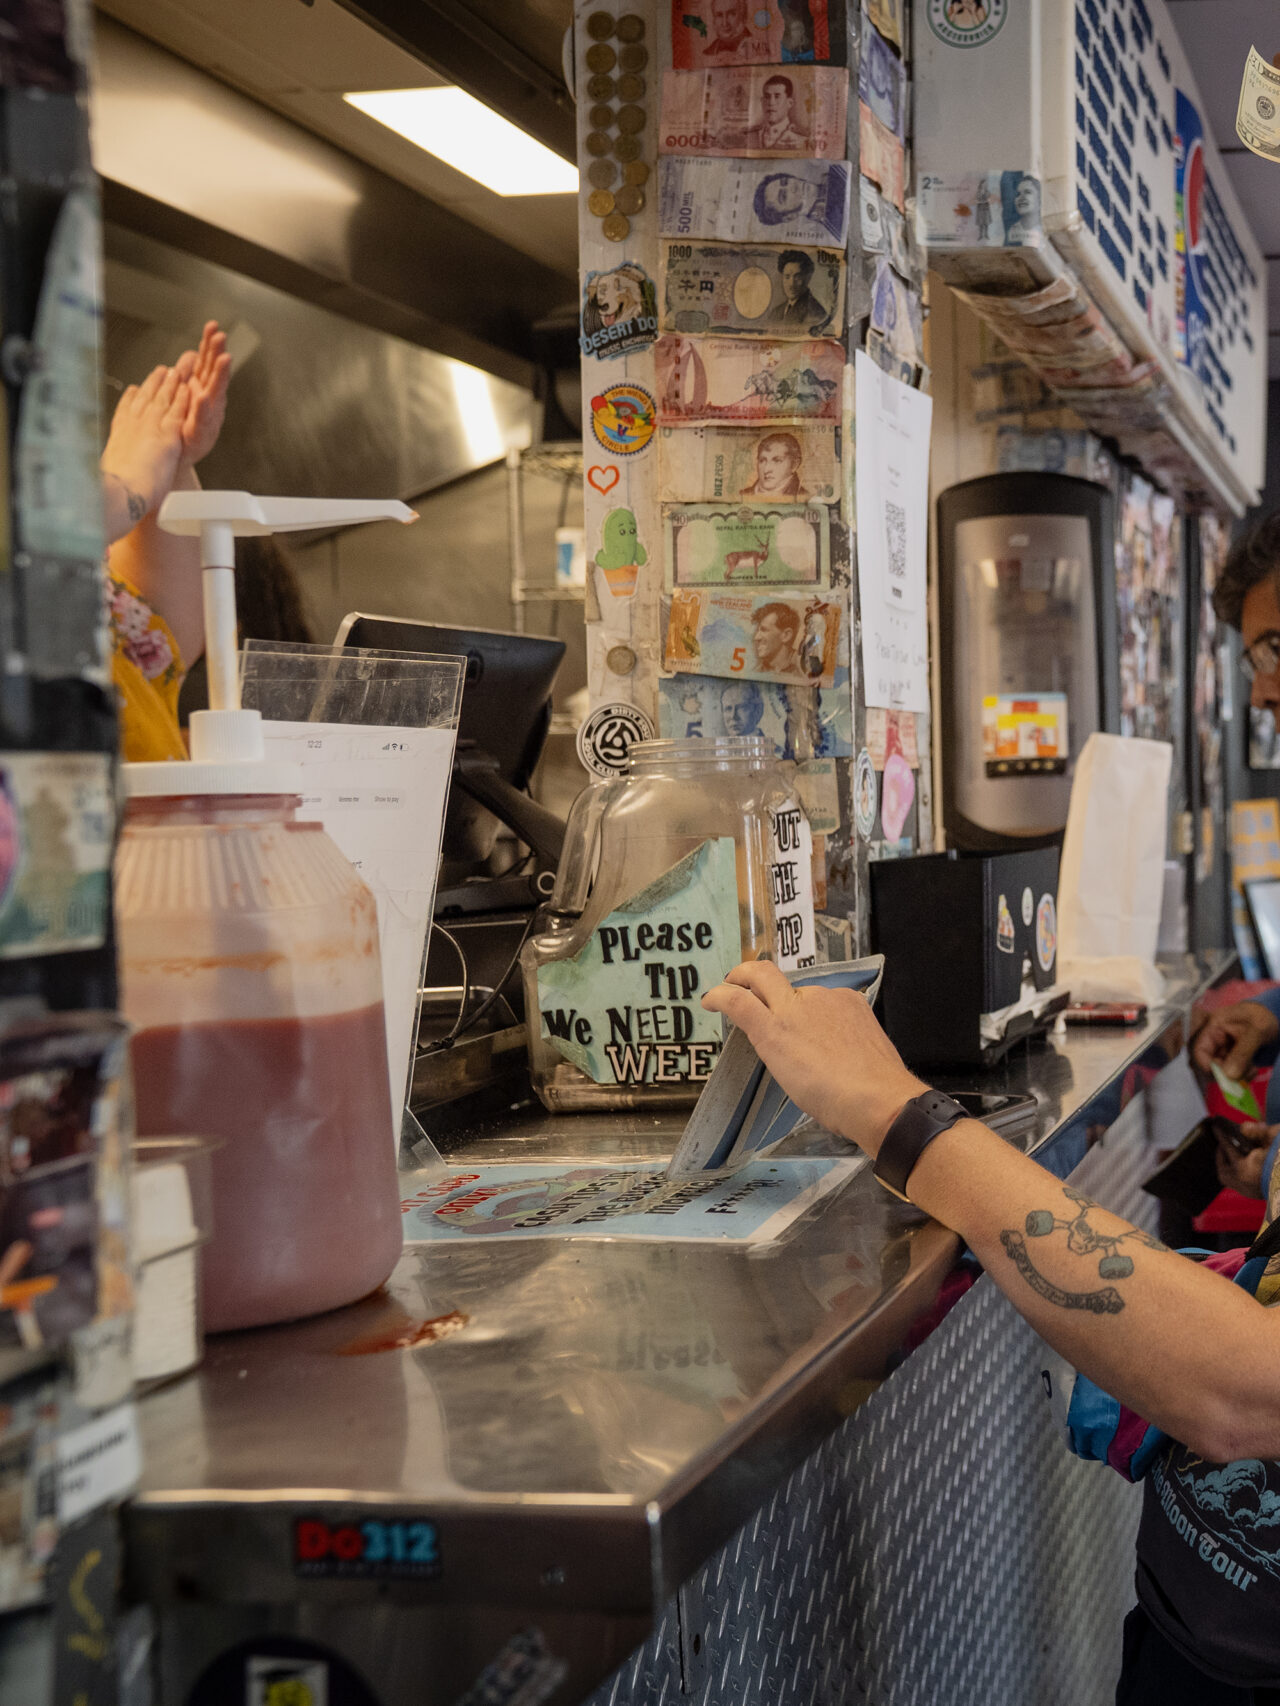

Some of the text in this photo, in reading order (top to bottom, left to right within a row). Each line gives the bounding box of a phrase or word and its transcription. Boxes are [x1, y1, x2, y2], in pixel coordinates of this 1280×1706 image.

[678, 206, 693, 233] 500
[579, 319, 634, 354] DESERT
[601, 435, 631, 451] CIRCLE
[729, 647, 746, 672] 5
[542, 1005, 693, 1046] We NEED
[513, 1202, 583, 1229] CASH
[559, 1181, 620, 1203] TIPS
[298, 1521, 438, 1562] Do312
[1198, 1531, 1259, 1592] Tour
